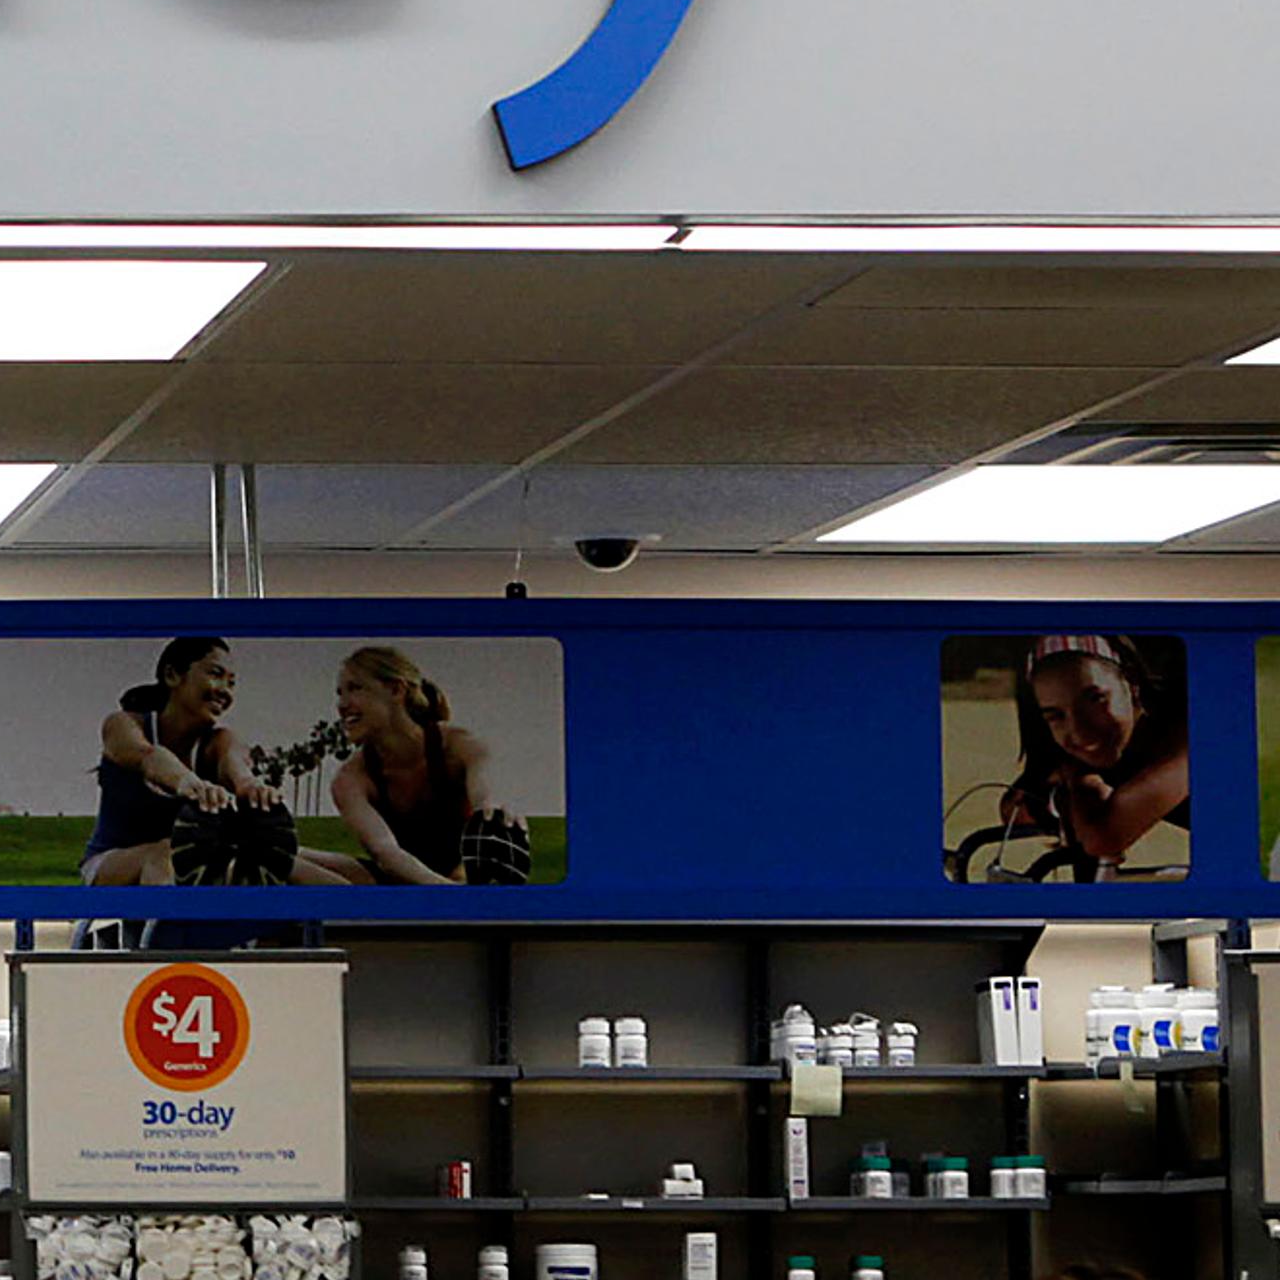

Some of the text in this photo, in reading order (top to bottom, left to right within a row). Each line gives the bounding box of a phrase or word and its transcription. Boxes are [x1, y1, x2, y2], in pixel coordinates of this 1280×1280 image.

[151, 990, 221, 1058] $4
[141, 1100, 236, 1130] 30-day
[134, 1162, 158, 1173] Free
[160, 1162, 193, 1173] Home
